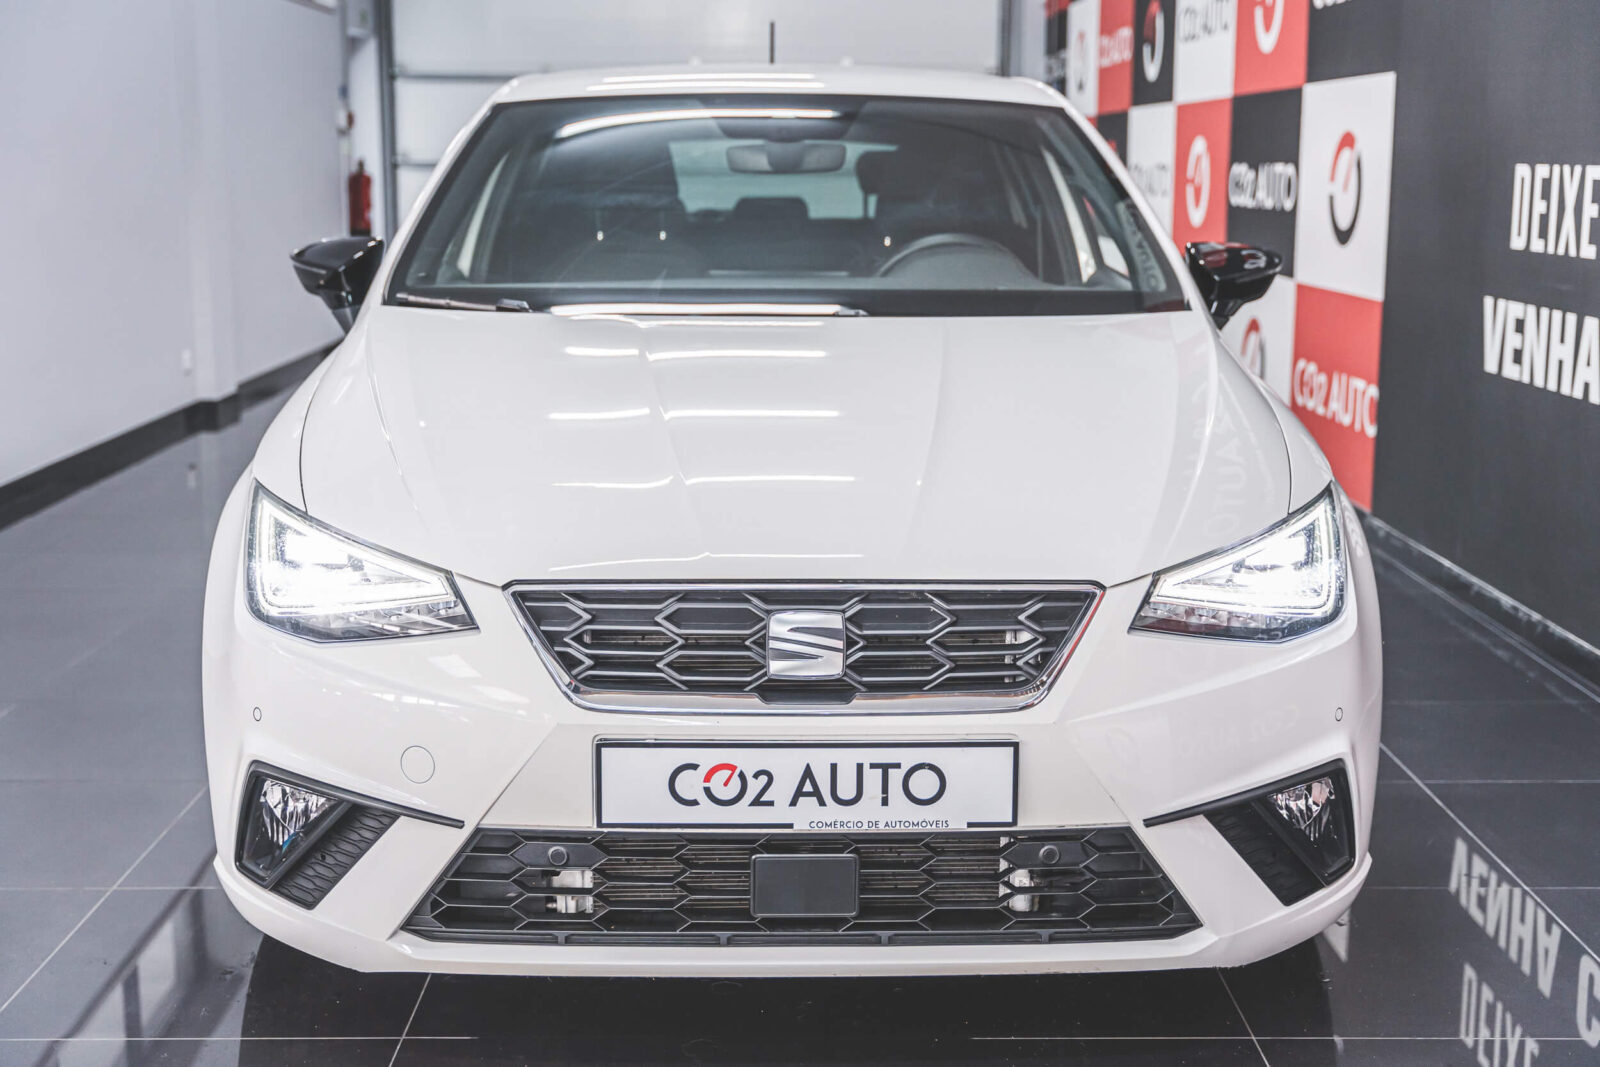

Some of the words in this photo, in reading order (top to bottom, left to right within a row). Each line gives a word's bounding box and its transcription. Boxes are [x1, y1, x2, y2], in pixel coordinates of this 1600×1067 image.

[1256, 161, 1297, 212] AUTO
[1509, 163, 1600, 260] DEIXE
[1483, 295, 1600, 406] VENHA
[668, 763, 775, 807] CO2
[789, 763, 947, 807] AUTO
[808, 818, 864, 830] COMÉRCIO
[867, 820, 880, 829] DE
[883, 818, 950, 830] AUTOMÓVEIS
